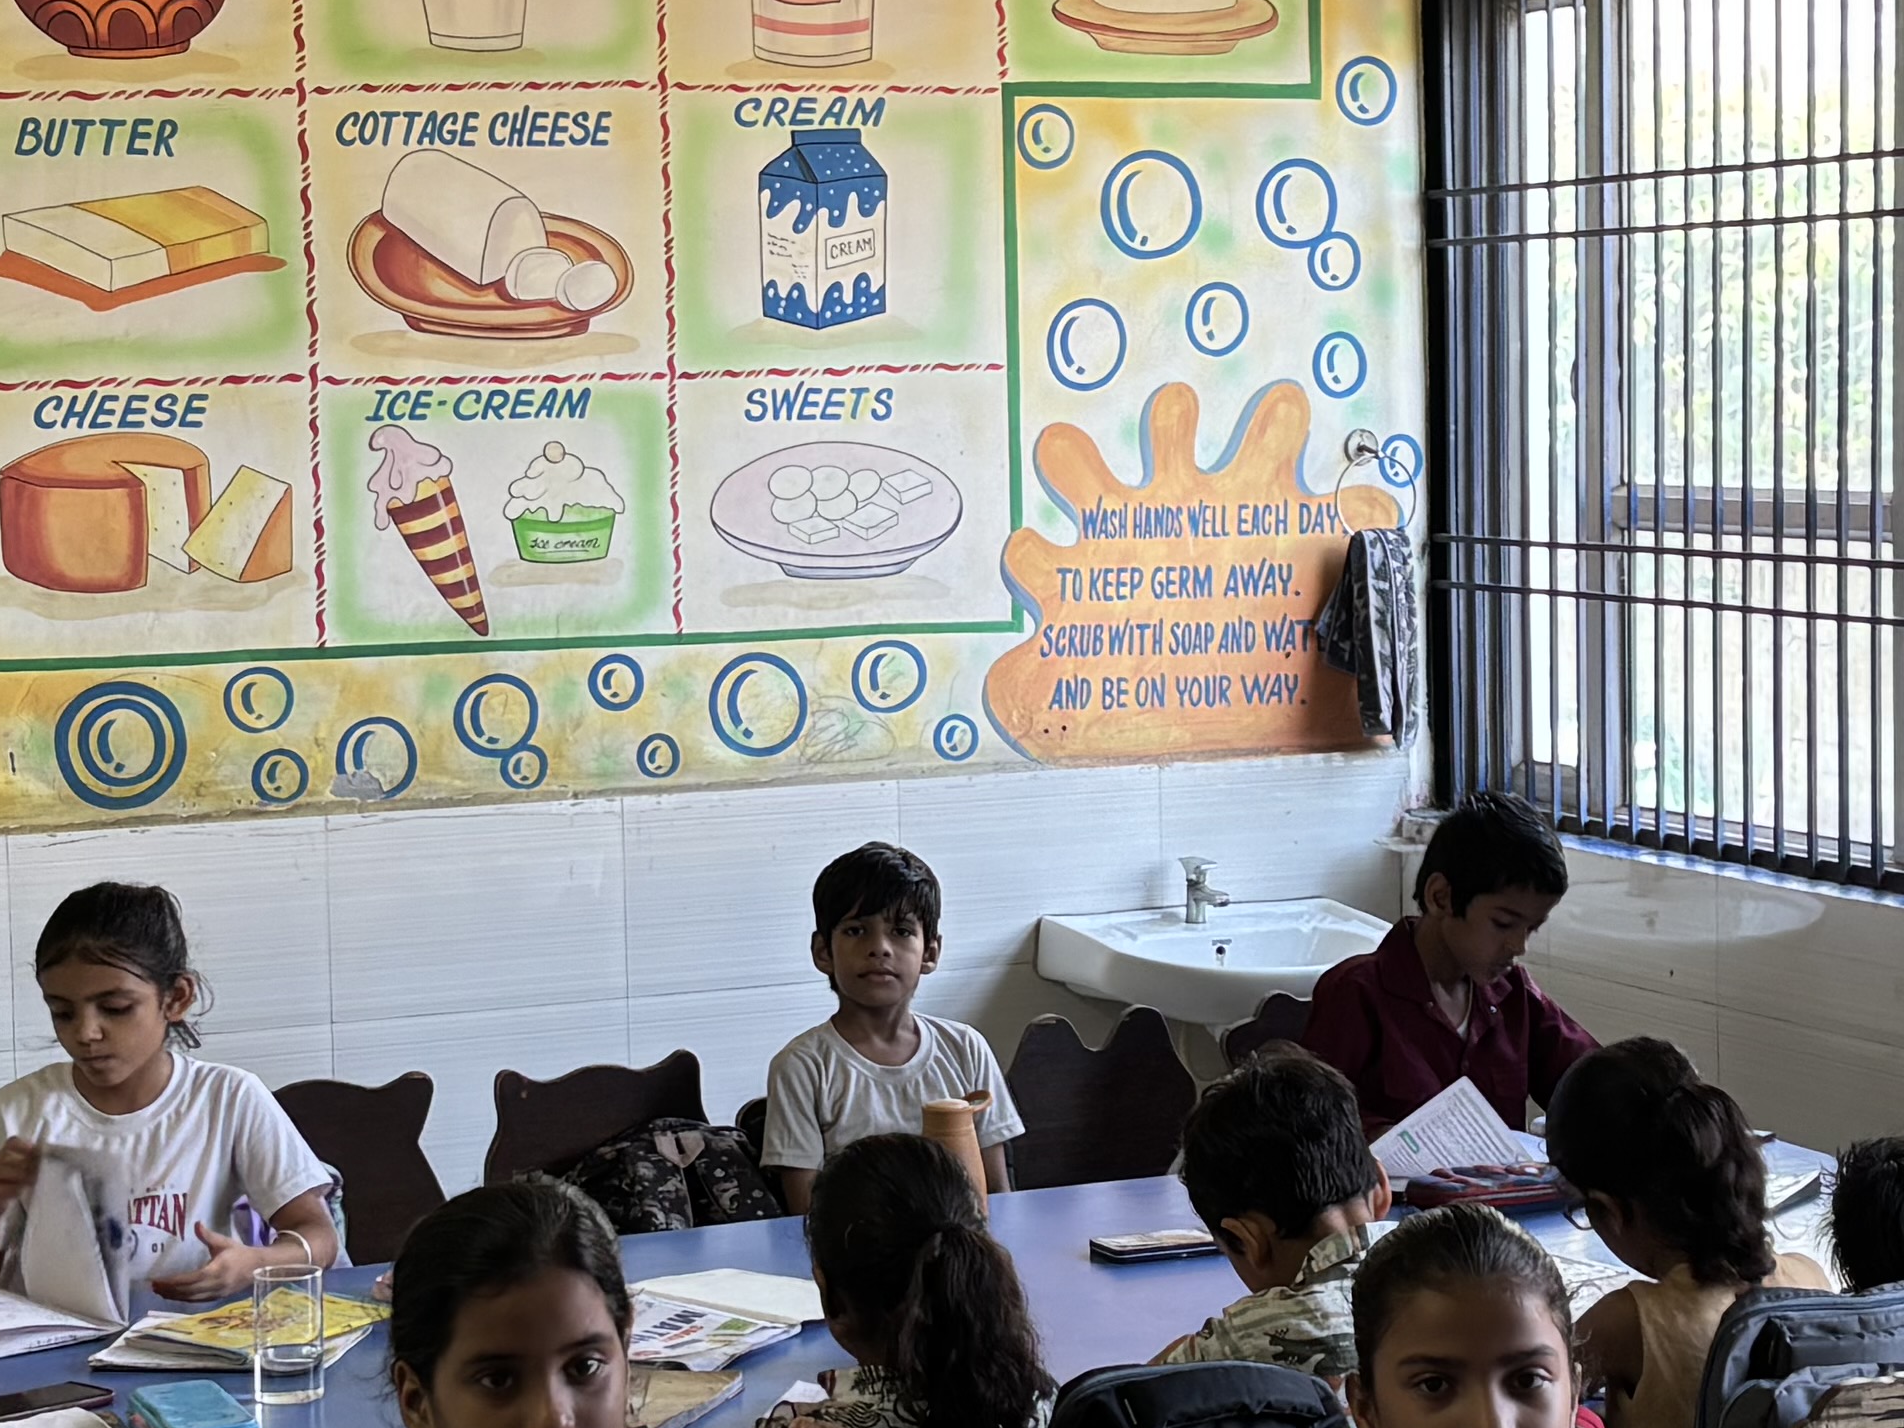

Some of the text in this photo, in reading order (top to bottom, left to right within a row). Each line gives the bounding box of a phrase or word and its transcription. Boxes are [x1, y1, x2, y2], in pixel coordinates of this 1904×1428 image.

[336, 106, 612, 147] COTTAGE CHEESE
[734, 97, 886, 128] CREAM
[15, 118, 179, 157] BUTTER
[830, 237, 872, 259] CREAM
[33, 391, 209, 429] CHEESE
[366, 388, 591, 423] ICE-CREAM
[744, 381, 894, 422] SWEETS
[1081, 495, 1128, 540] WASH
[1133, 503, 1183, 540] HANDS
[1188, 499, 1229, 538] WELL
[1237, 499, 1289, 536] EACH
[1057, 567, 1082, 602] TO
[1088, 567, 1143, 602] KEEP
[1151, 564, 1213, 600] GERM
[1040, 613, 1327, 659] SCRUB WITH SOAP AND WAT
[1049, 677, 1092, 711] AND
[1101, 677, 1129, 710] BE
[1135, 674, 1165, 708] ON
[1176, 675, 1231, 707] YOUR
